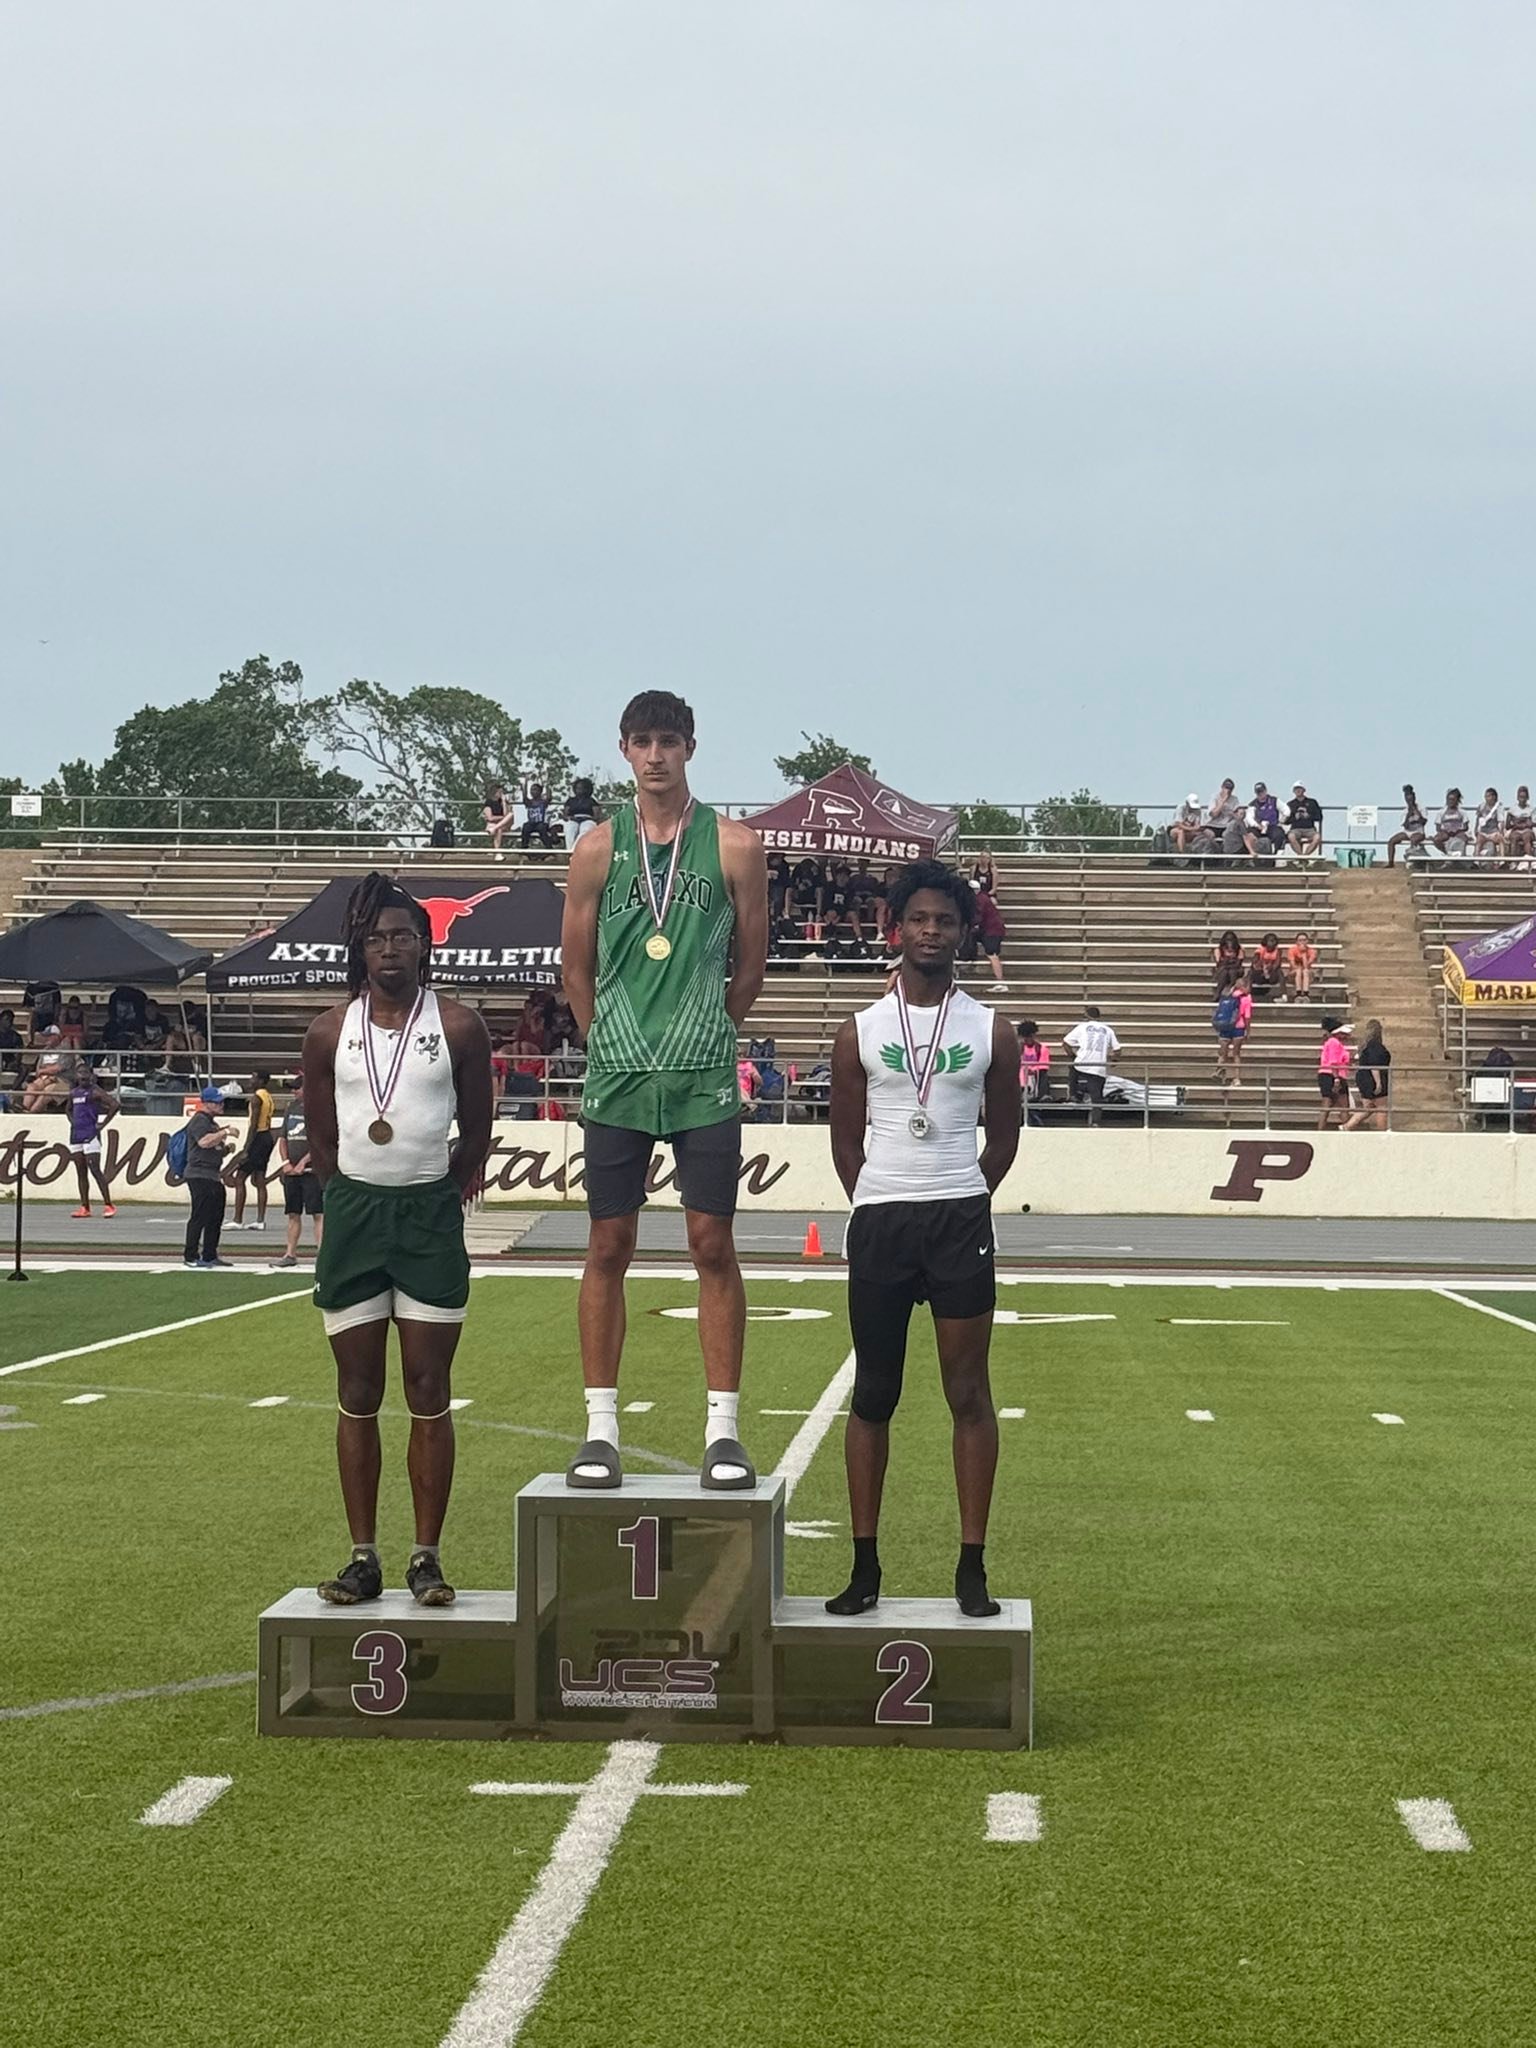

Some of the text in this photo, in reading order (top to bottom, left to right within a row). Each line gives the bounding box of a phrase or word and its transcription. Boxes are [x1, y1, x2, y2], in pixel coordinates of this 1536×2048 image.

[757, 828, 817, 848] ESEL
[824, 832, 920, 859] INDIANS
[268, 942, 349, 963] AXT
[228, 971, 300, 987] PROUDLY
[305, 969, 348, 984] SPON
[1210, 1139, 1314, 1202] P
[618, 1516, 660, 1600] 1
[351, 1630, 408, 1715] 3
[560, 1658, 716, 1695] UCS
[875, 1639, 933, 1725] 2
